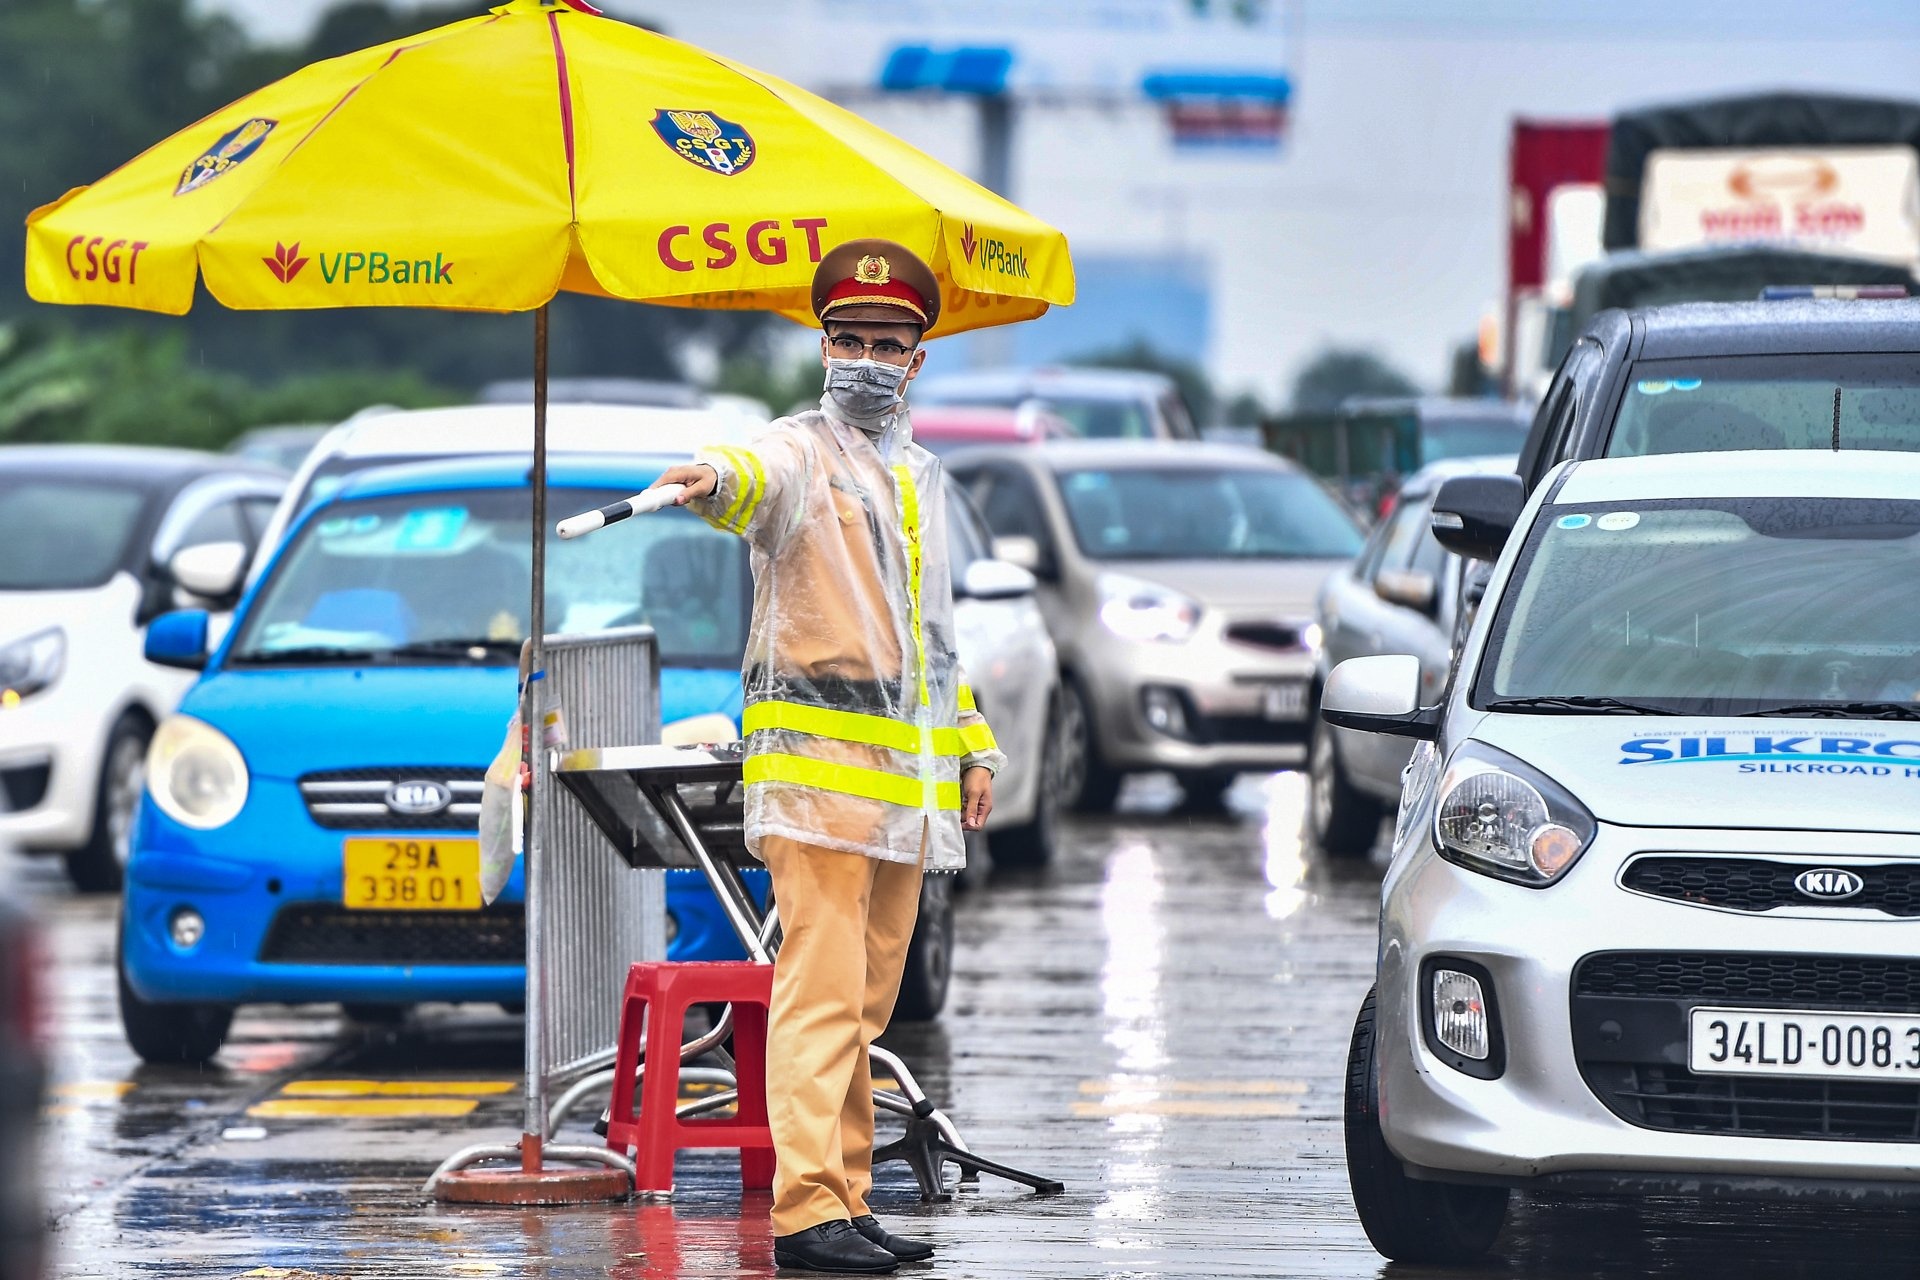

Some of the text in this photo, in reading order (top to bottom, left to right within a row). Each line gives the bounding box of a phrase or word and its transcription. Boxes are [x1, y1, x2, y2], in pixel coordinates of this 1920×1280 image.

[676, 138, 746, 150] CSGT
[657, 217, 828, 272] CSGT
[66, 235, 149, 285] CSGT
[319, 251, 454, 285] VPBank
[979, 237, 1030, 279] VPBank
[1814, 730, 1887, 738] materials
[1738, 763, 1891, 776] SILKROAD
[395, 786, 440, 805] KIA
[386, 843, 439, 869] 29A
[1806, 873, 1853, 893] KIA
[1709, 1020, 1920, 1069] 34LD-008.3
